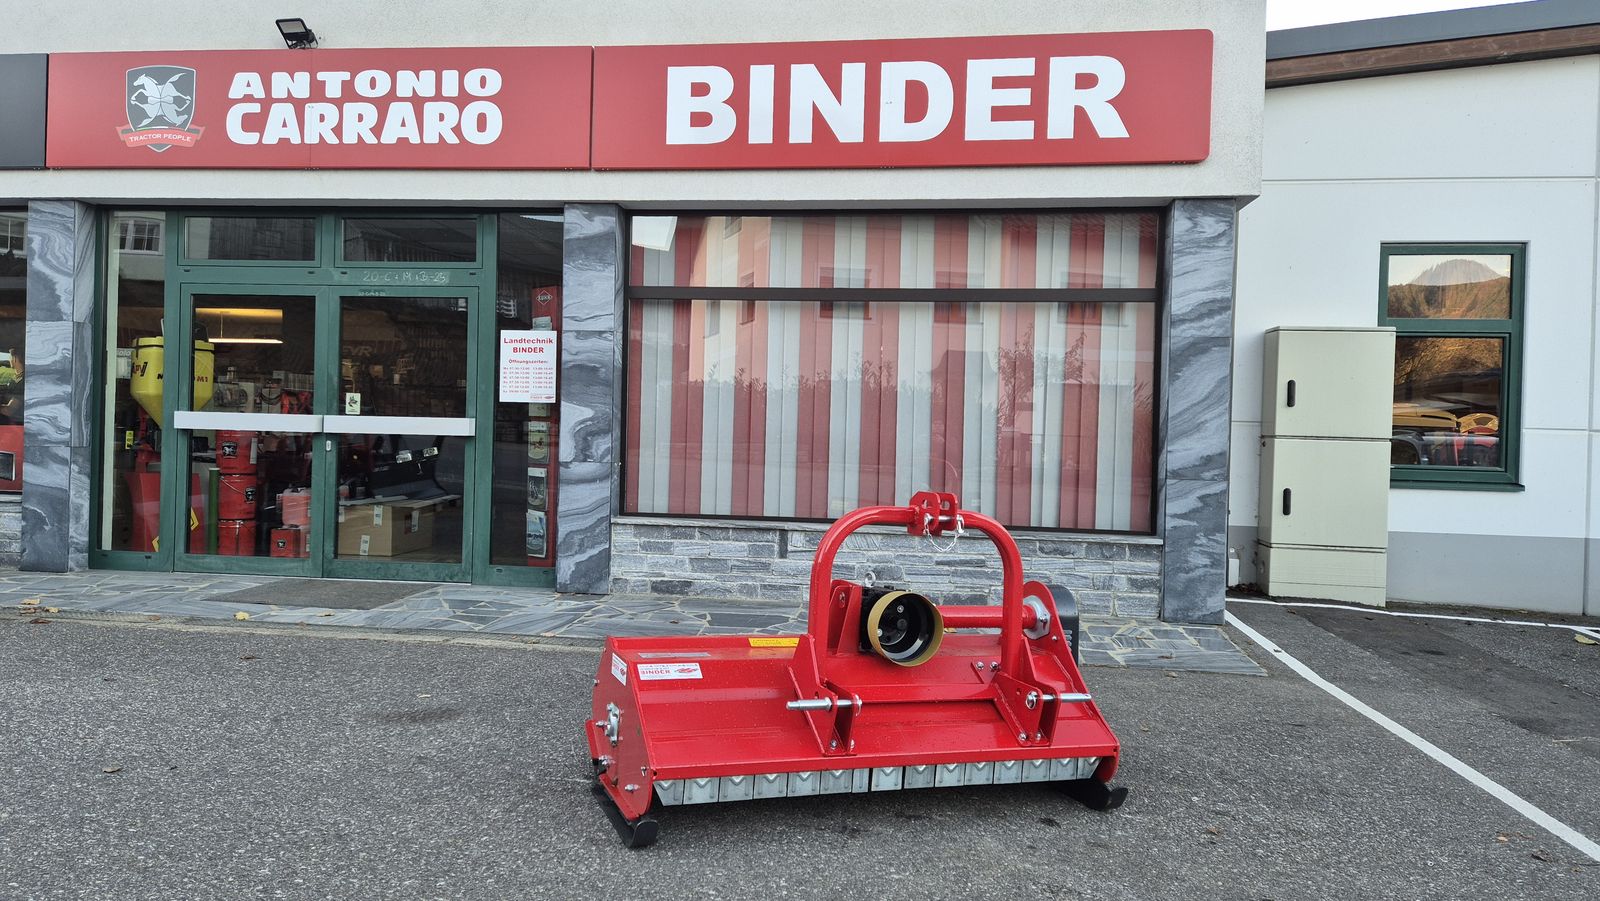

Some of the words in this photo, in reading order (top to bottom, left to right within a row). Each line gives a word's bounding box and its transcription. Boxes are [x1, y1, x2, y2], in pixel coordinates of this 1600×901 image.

[228, 68, 502, 99] ANTONIO
[666, 55, 1130, 144] BINDER
[129, 133, 162, 142] TRACTOR
[163, 133, 192, 142] PEOPLE
[226, 101, 503, 145] CARRARO
[512, 346, 545, 354] BINDER
